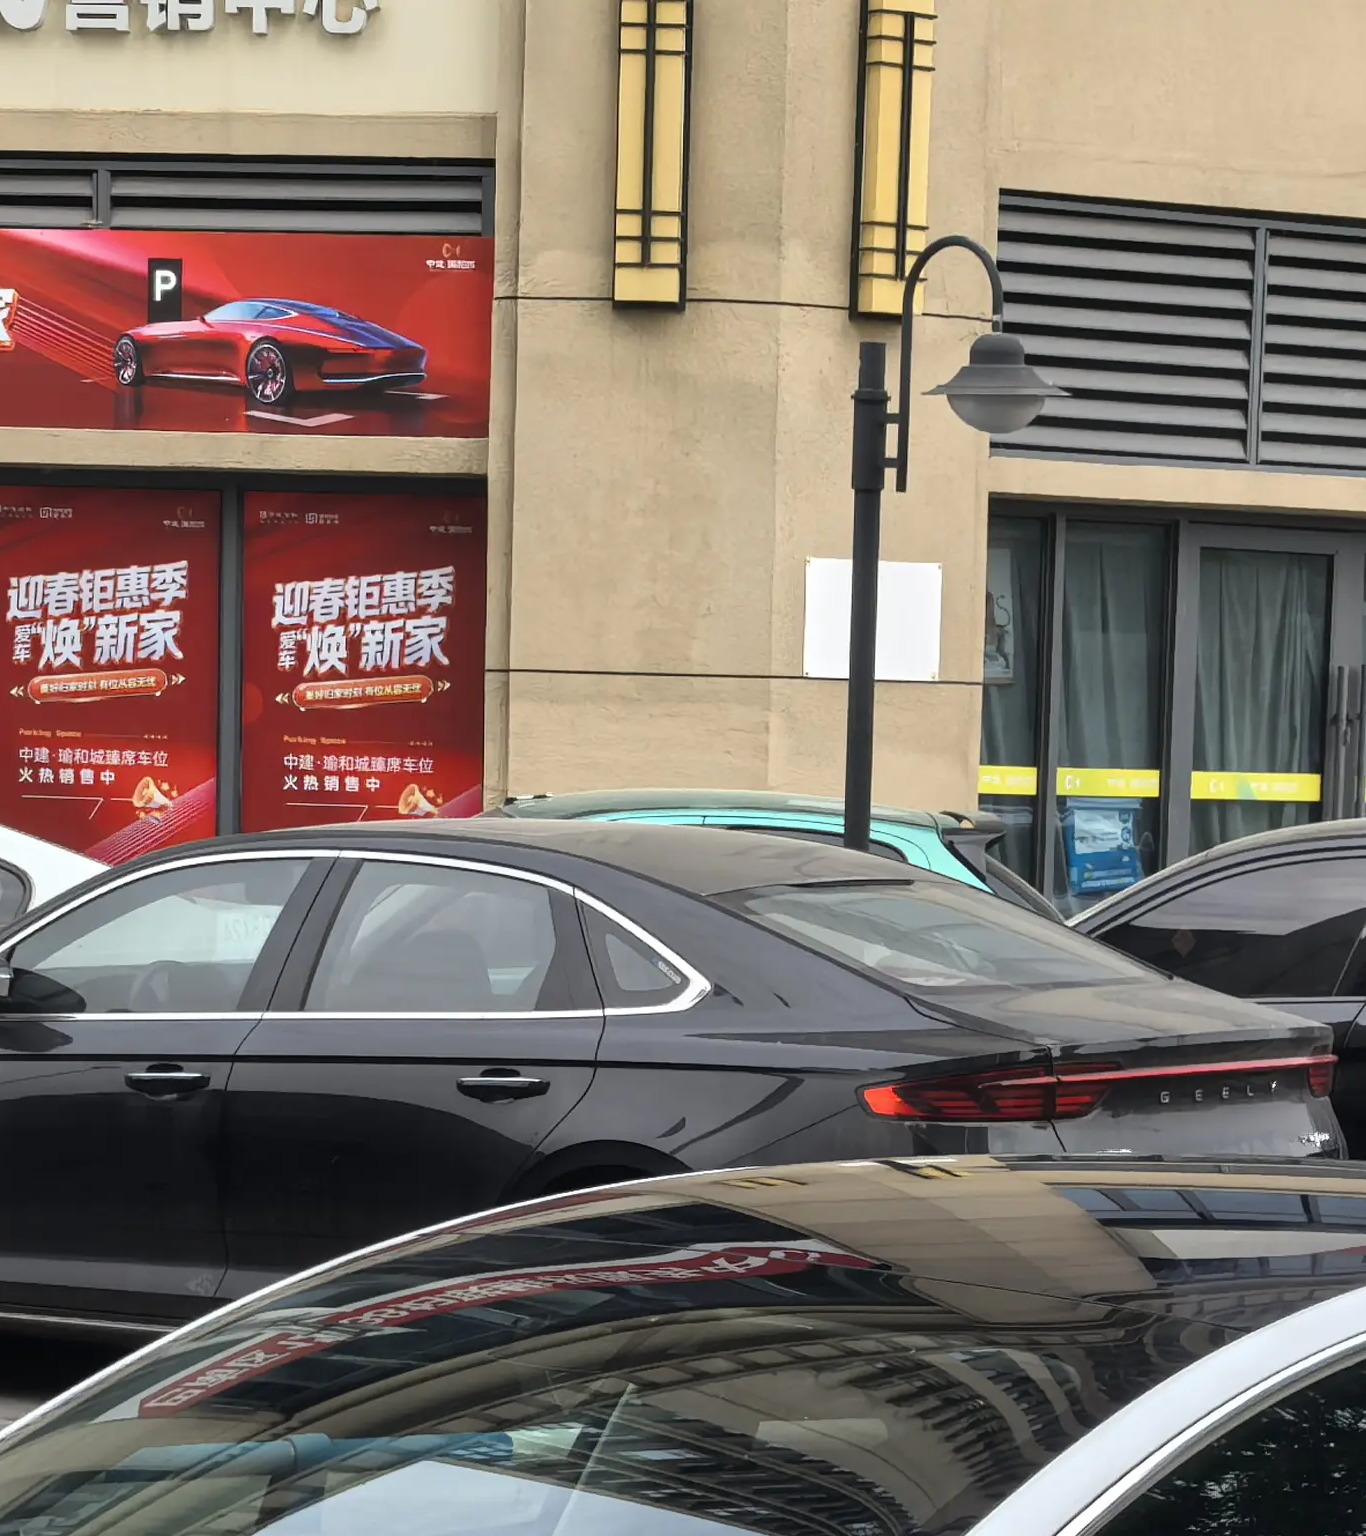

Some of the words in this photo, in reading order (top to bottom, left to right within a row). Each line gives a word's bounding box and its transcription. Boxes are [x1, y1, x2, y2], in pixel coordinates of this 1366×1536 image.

[154, 269, 176, 301] P
[6, 560, 188, 623] 迎春钜惠季
[271, 565, 455, 629] 迎春钜惠季
[18, 767, 116, 786] 火热销售中
[283, 775, 381, 793] 火热销售中
